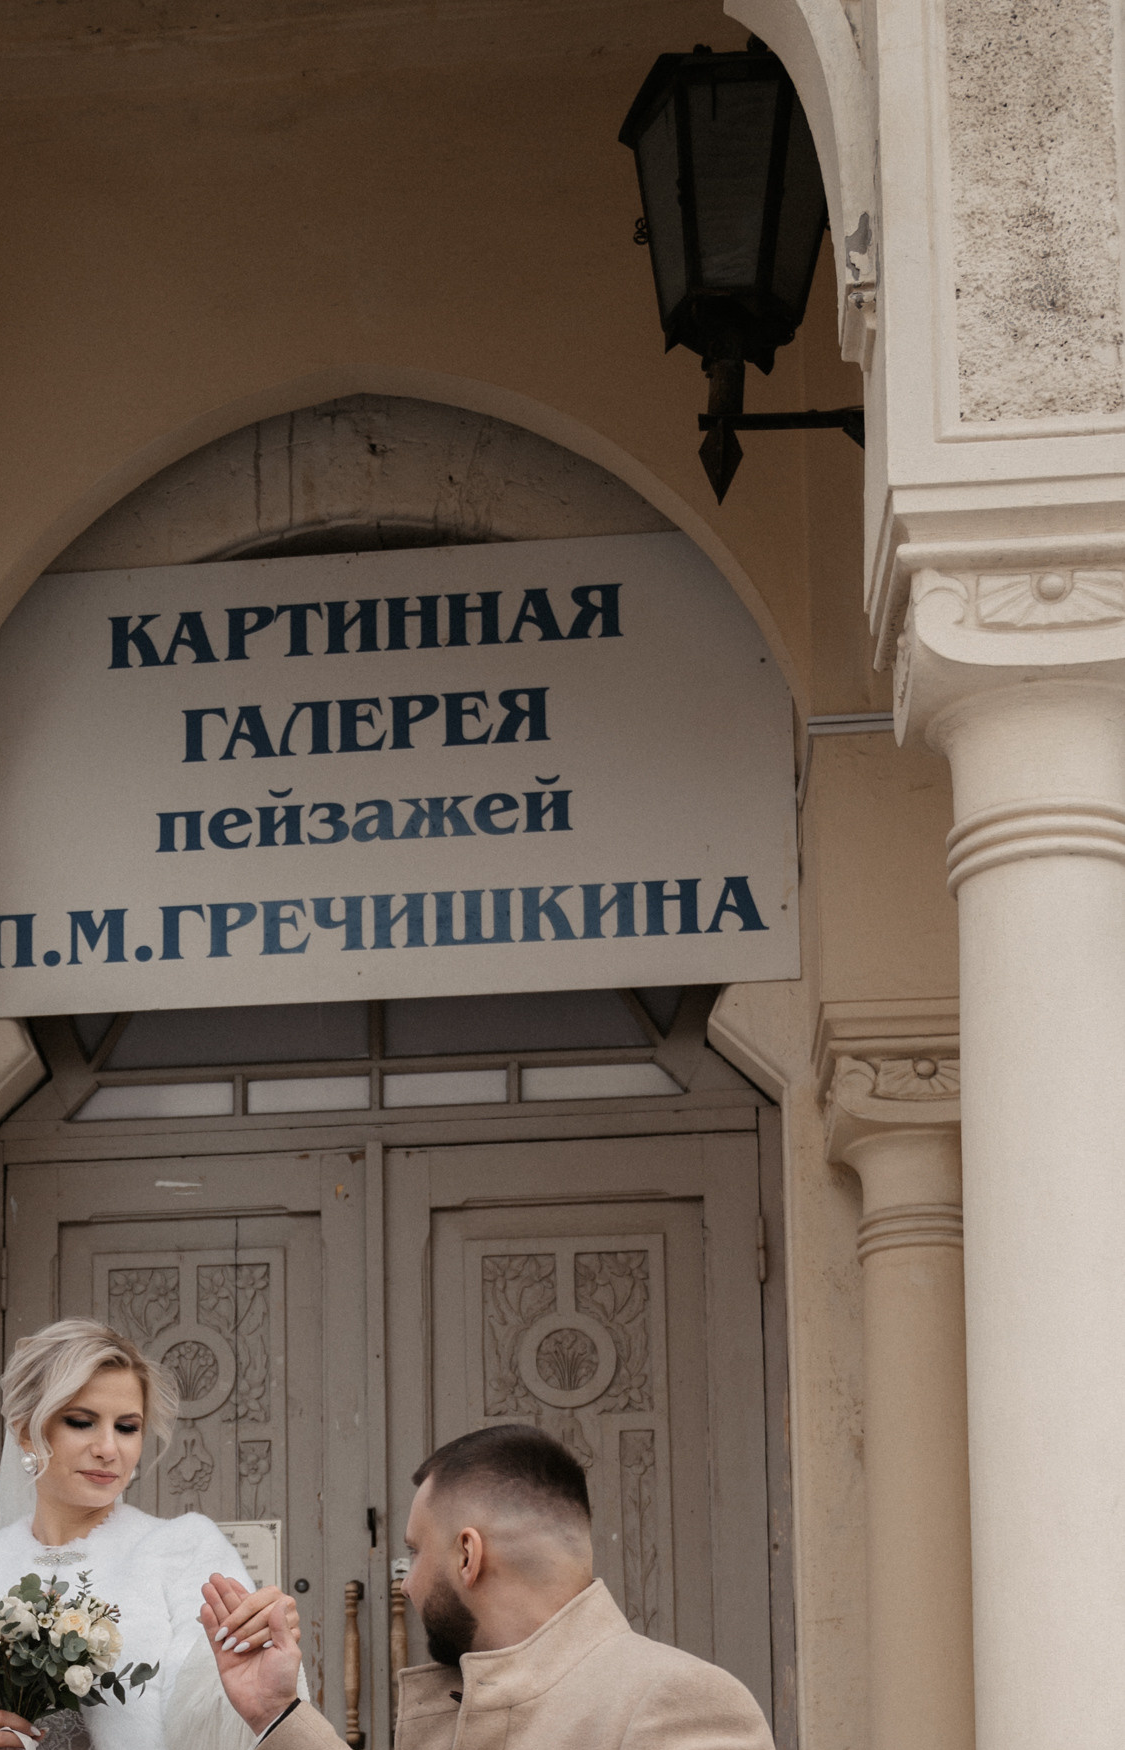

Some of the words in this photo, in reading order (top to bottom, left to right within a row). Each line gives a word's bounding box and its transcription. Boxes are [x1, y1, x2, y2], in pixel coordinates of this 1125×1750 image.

[108, 583, 624, 669] КАРТИННАЯ
[181, 687, 551, 763] ГАЛЕРЕЯ
[156, 775, 574, 853] пейзажей
